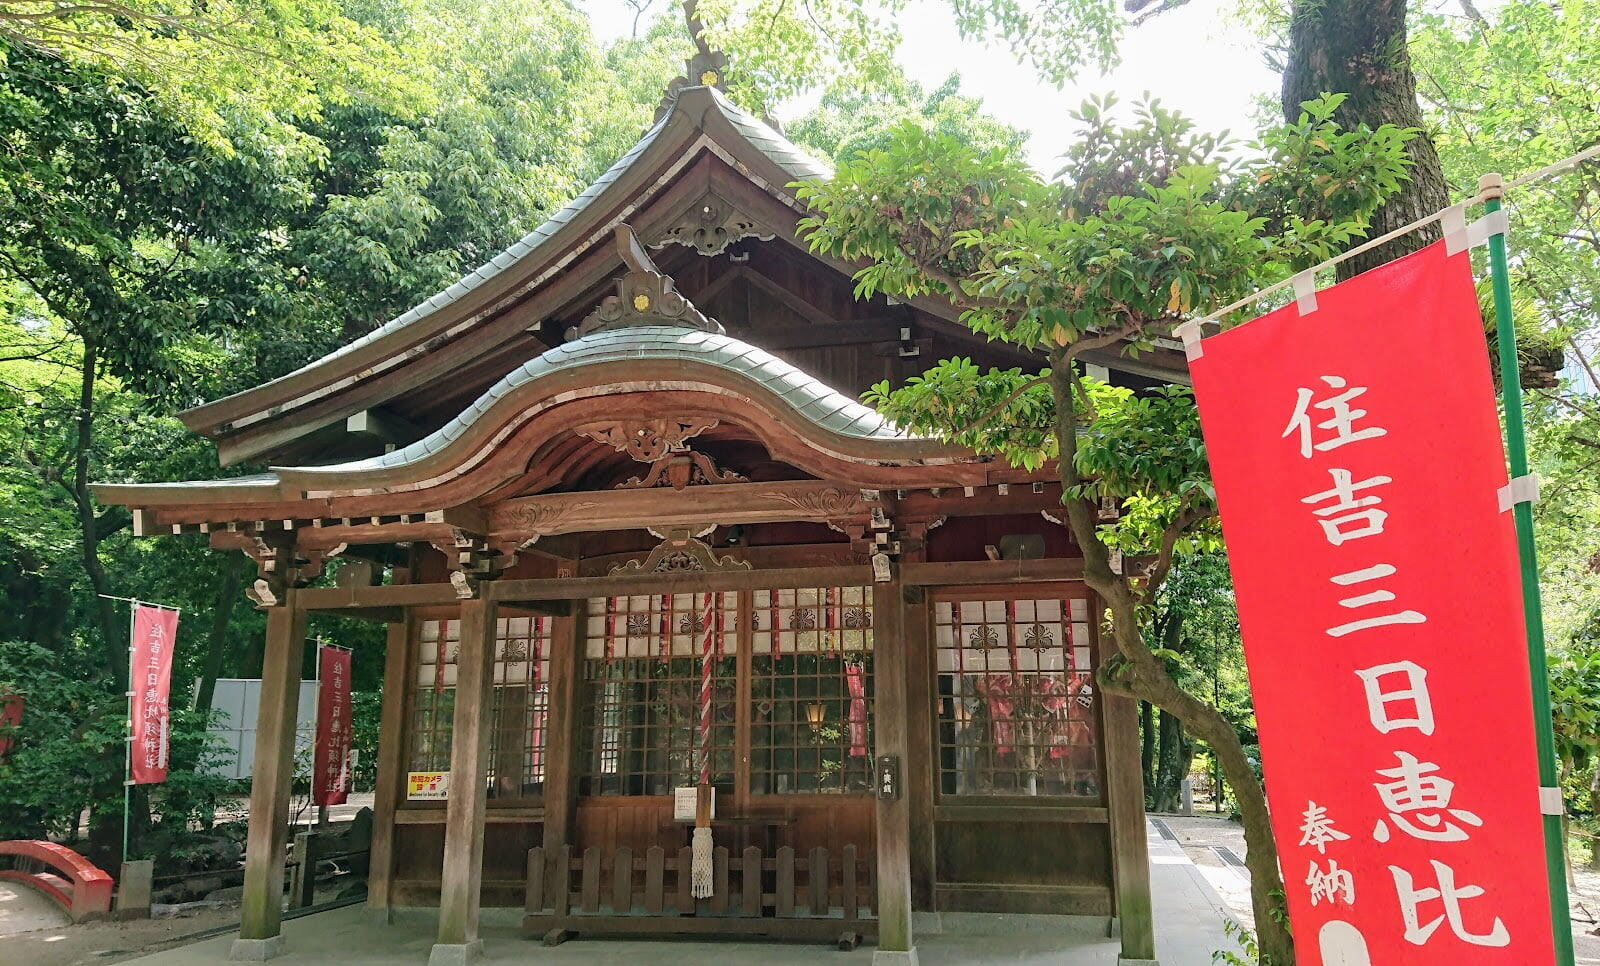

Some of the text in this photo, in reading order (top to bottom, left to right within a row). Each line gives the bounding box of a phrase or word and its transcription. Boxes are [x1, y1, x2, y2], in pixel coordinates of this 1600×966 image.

[1282, 375, 1511, 947] 住吉三日恵比
[1299, 800, 1357, 907] 奉納
